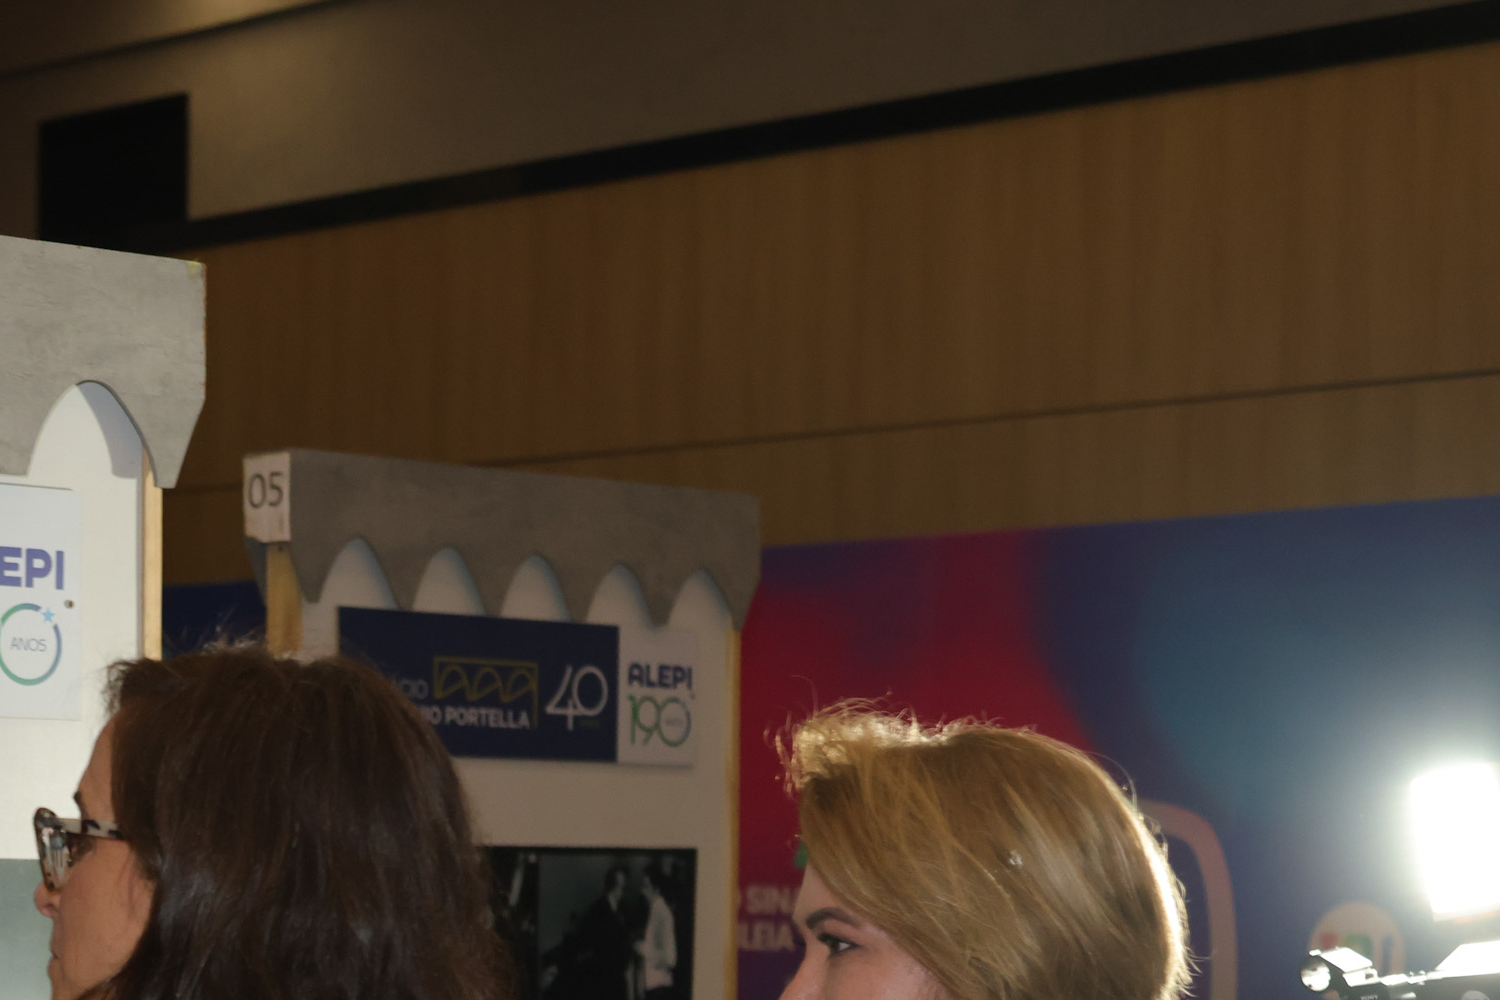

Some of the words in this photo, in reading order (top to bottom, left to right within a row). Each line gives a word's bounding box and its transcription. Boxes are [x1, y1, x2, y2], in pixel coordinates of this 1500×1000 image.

[248, 471, 284, 508] 05
[10, 637, 47, 652] ANOS
[628, 662, 694, 690] ALEPI
[545, 665, 609, 731] 40
[444, 706, 531, 730] PORTELLA
[628, 694, 692, 748] 190
